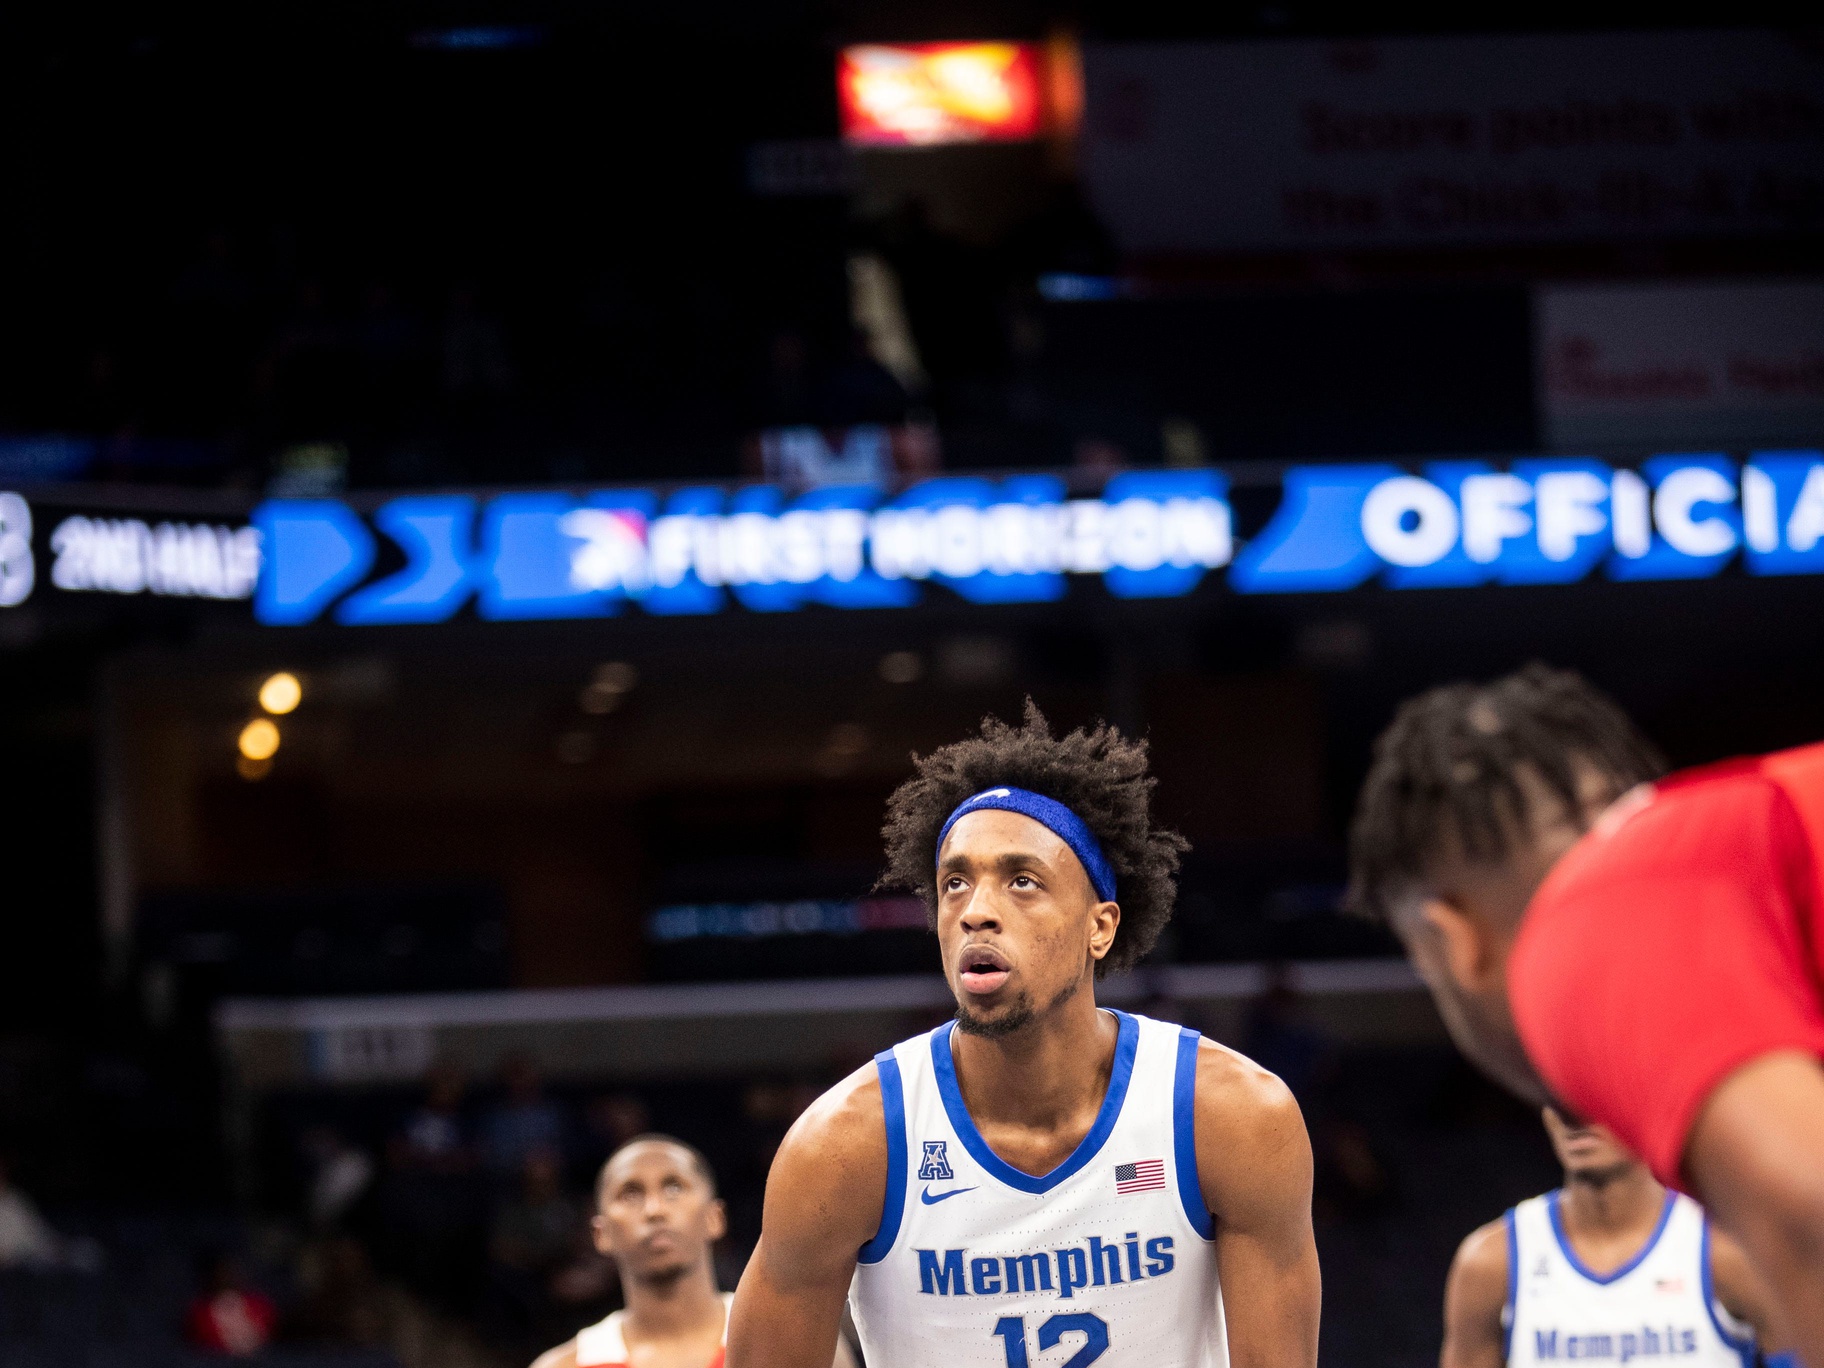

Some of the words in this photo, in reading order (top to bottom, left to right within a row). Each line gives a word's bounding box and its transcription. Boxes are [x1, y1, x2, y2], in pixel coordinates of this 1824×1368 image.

[647, 508, 866, 585] FIRST
[870, 499, 1232, 580] HORIZON
[911, 1230, 1175, 1300] Memphis
[1534, 1324, 1698, 1365] Memphis
